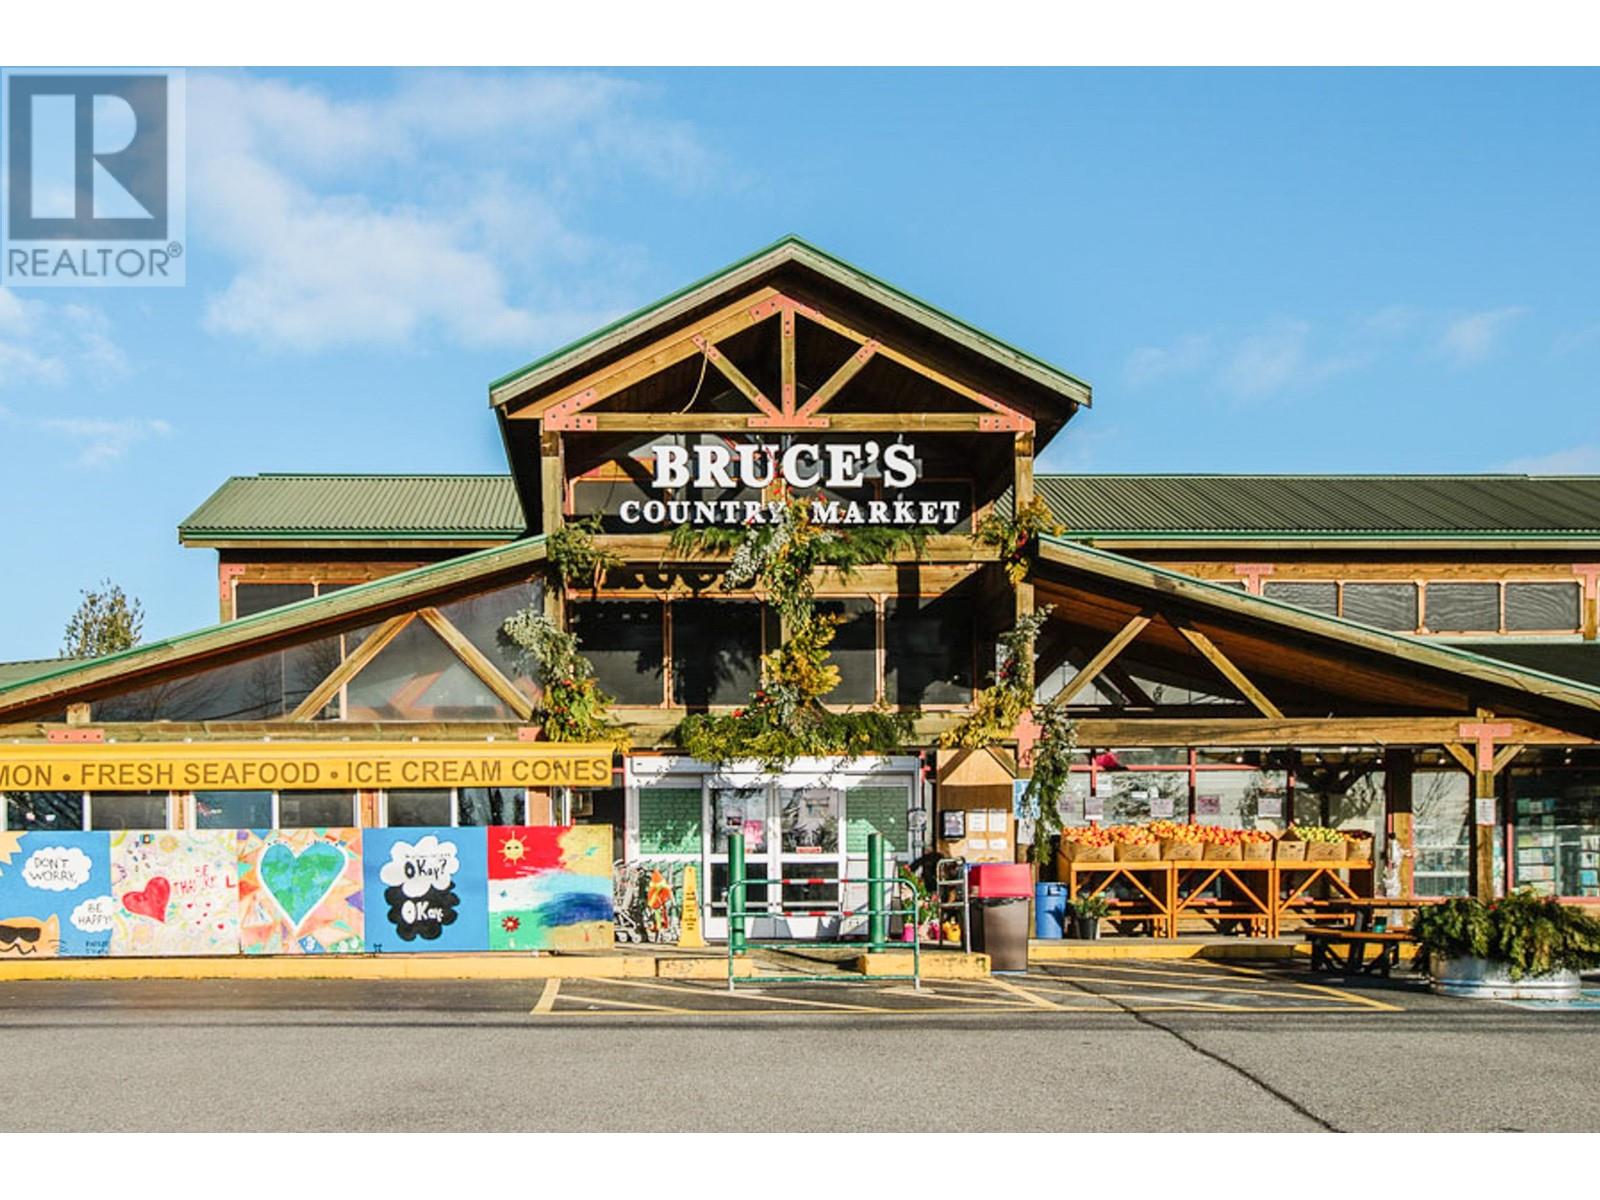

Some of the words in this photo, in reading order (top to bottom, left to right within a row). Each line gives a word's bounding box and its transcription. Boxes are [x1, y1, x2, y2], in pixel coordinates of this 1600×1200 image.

[651, 440, 919, 488] BRUCE'S
[619, 501, 787, 525] COUNTRY
[811, 501, 960, 525] MARKET
[81, 763, 173, 785] FRESH
[183, 762, 320, 785] SEAFOOD
[347, 761, 392, 783] ICE
[402, 760, 501, 782] CREAM
[511, 759, 608, 781] CONES
